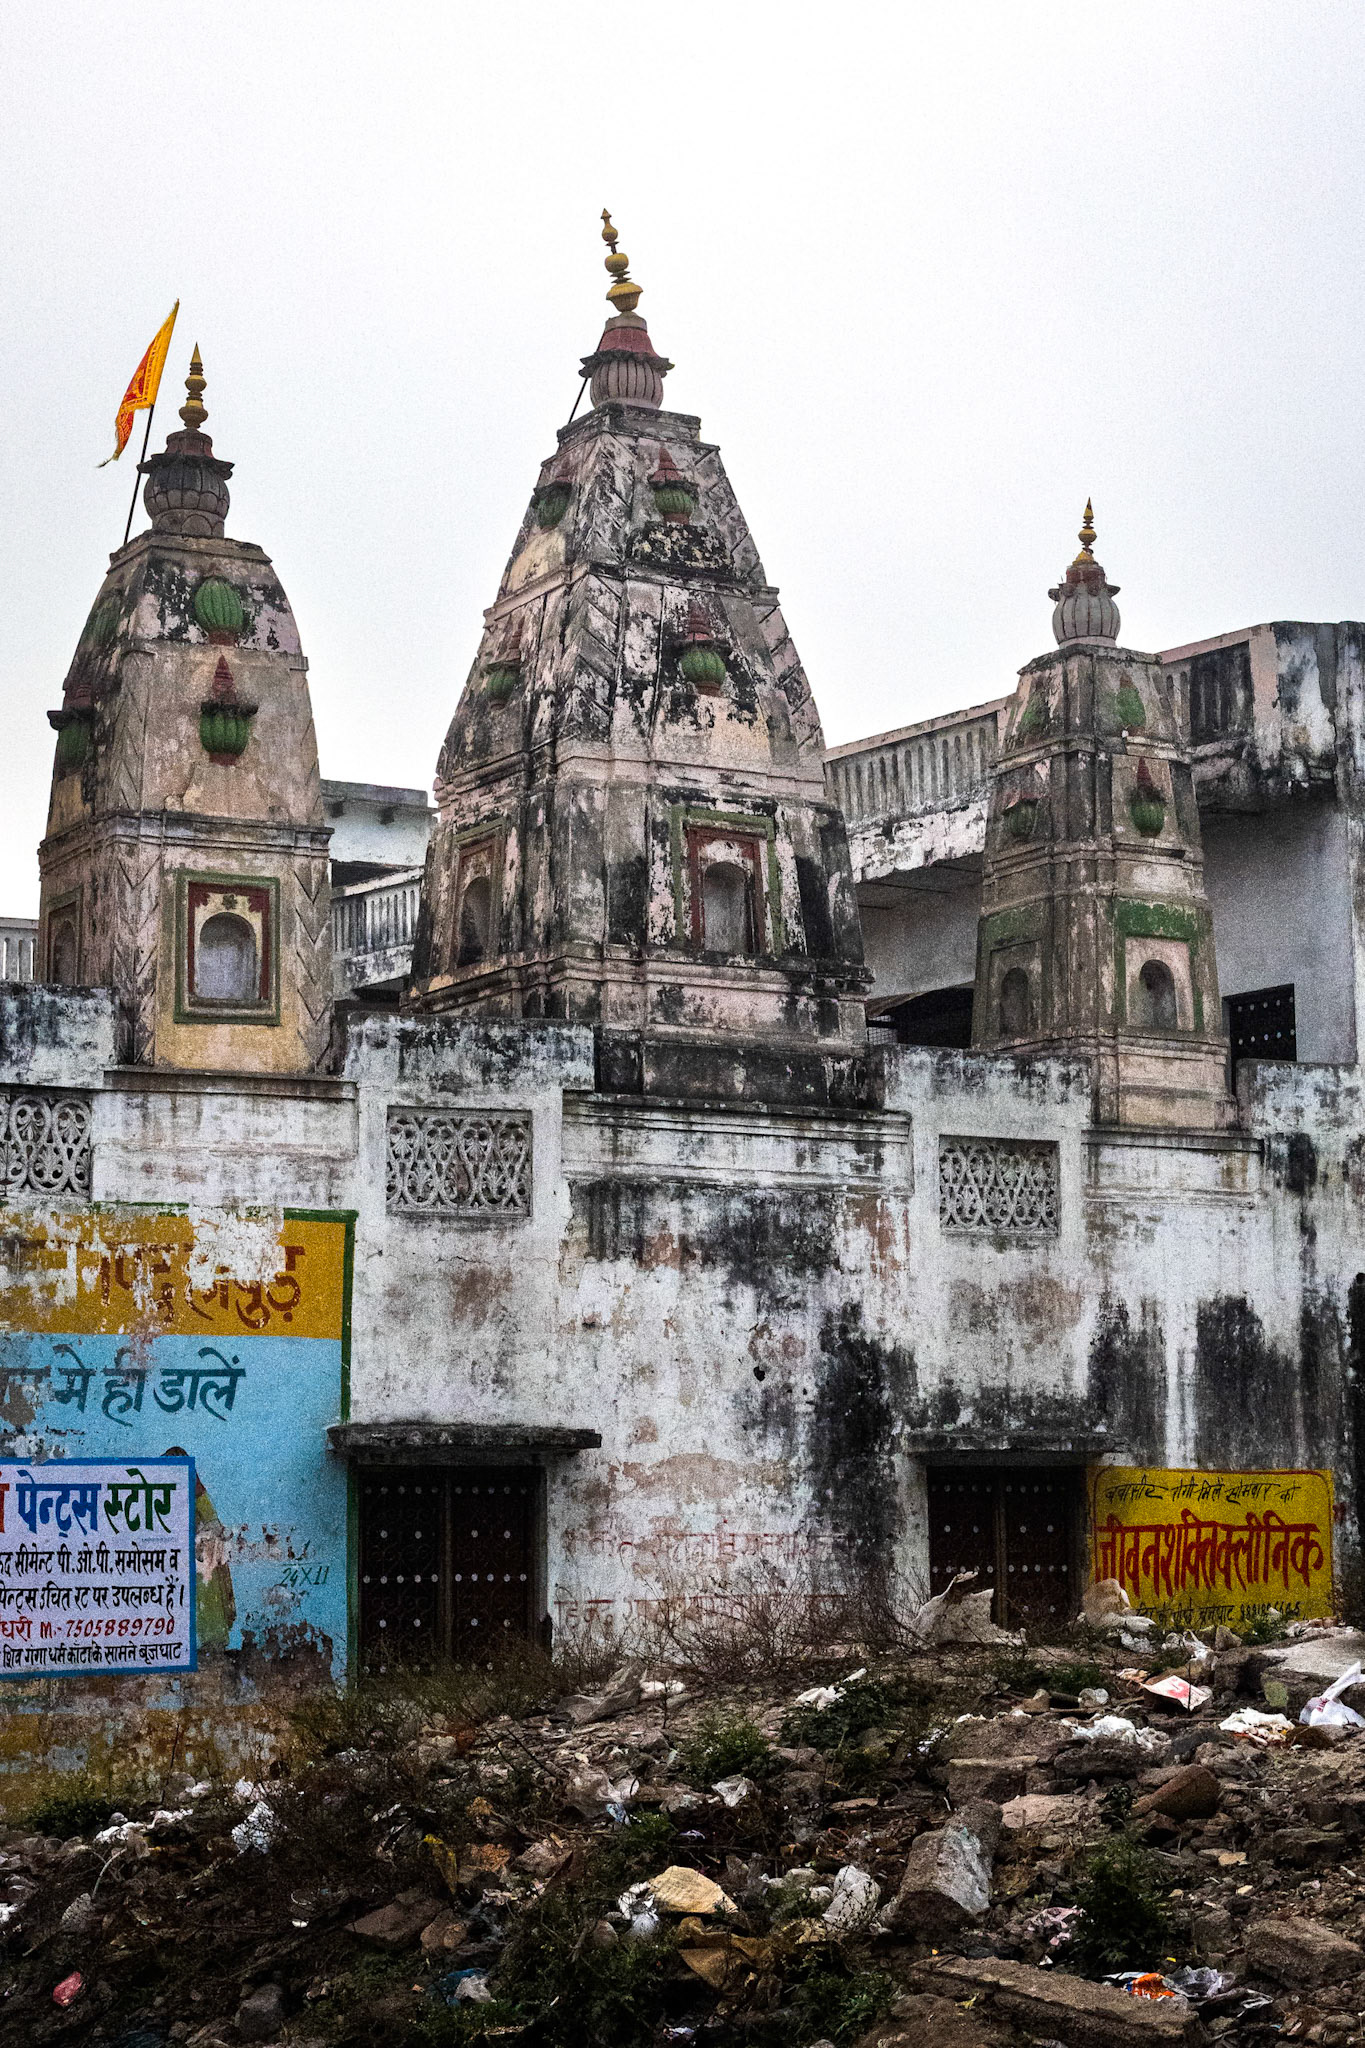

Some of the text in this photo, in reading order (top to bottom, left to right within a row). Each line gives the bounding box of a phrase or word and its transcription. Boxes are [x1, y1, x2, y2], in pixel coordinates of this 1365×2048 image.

[153, 1347, 246, 1421] डालें
[16, 1469, 101, 1537] पेन्ट्स
[103, 1468, 176, 1534] स्टोर
[15, 1543, 54, 1577] सीमेन्ट
[115, 1541, 167, 1576] समोसम
[169, 1548, 181, 1571] व
[39, 1580, 72, 1611] उचित
[92, 1587, 109, 1609] पर
[112, 1584, 164, 1609] उपलब्ध
[66, 1617, 175, 1637] 7505889790
[3, 1643, 24, 1669] शिव
[24, 1644, 47, 1665] गंगा
[104, 1640, 137, 1665] सामने
